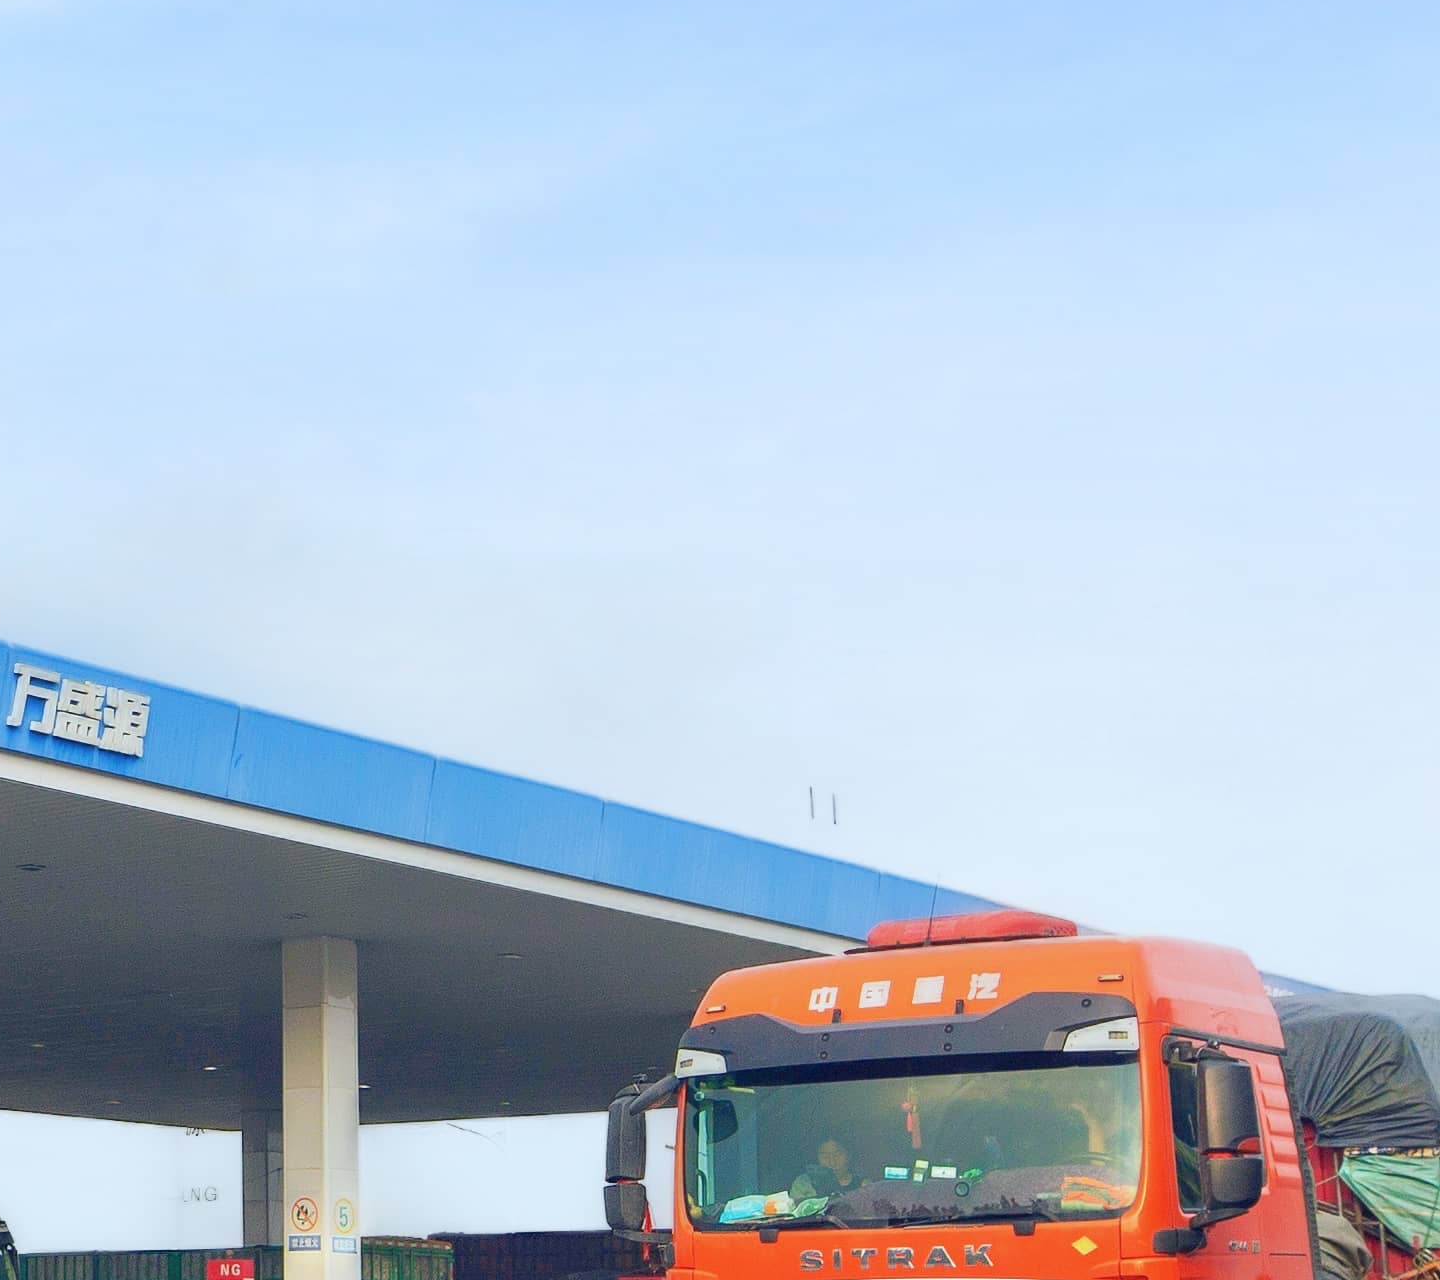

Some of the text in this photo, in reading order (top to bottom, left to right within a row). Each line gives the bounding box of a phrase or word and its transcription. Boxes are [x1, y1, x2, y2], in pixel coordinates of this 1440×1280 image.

[6, 662, 151, 758] 万盛源
[338, 1206, 349, 1228] 5
[799, 1243, 994, 1271] SITRAK
